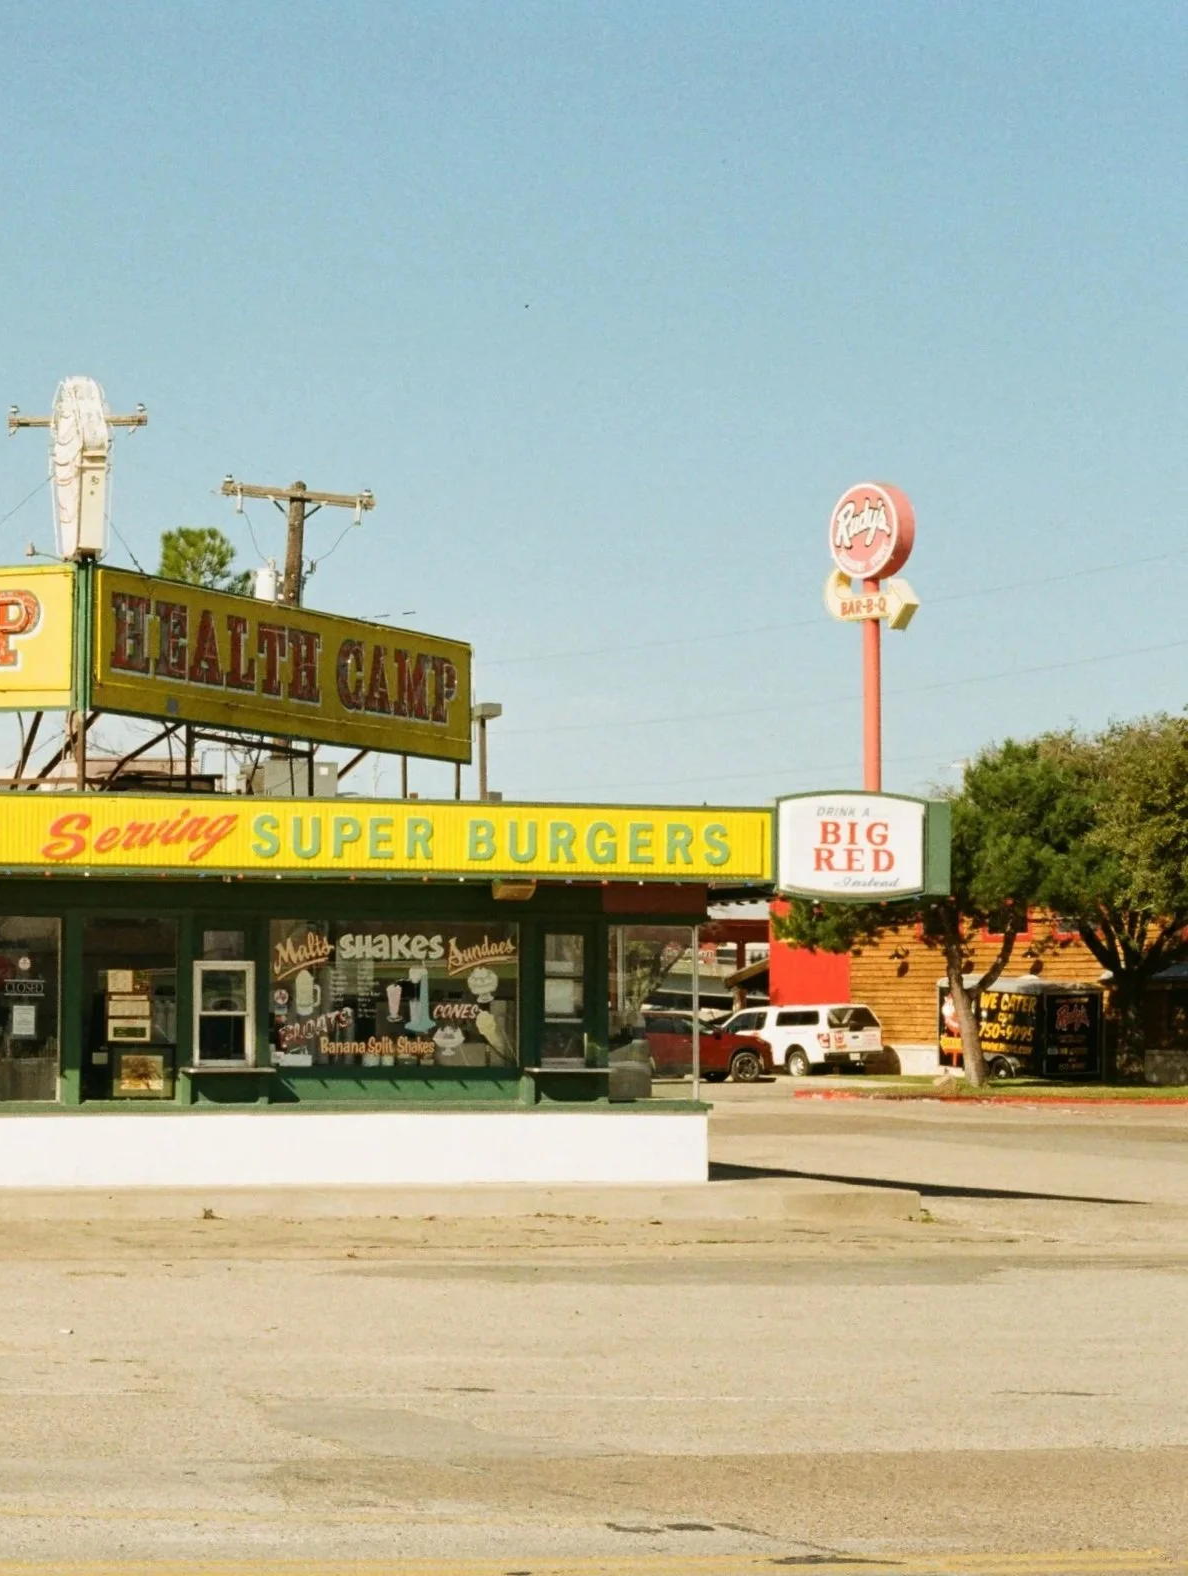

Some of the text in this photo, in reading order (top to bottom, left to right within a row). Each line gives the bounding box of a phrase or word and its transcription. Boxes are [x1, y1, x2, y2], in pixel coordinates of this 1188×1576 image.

[834, 497, 892, 550] Rudy's
[840, 597, 888, 616] BAR-B-Q
[110, 591, 459, 726] HEALTH CAMP
[816, 806, 871, 817] DRINK A
[41, 808, 240, 862] Serving
[252, 813, 435, 861] SUPER
[468, 818, 732, 866] BURGERS
[819, 821, 889, 846] BIG
[813, 847, 896, 873] RED
[273, 931, 335, 975] Malts
[447, 933, 516, 972] Sundaes
[5, 981, 44, 994] CLOSED
[432, 1002, 480, 1019] CONES
[980, 992, 1038, 1013] WE CATER
[320, 1035, 436, 1058] Banana Split Shakes
